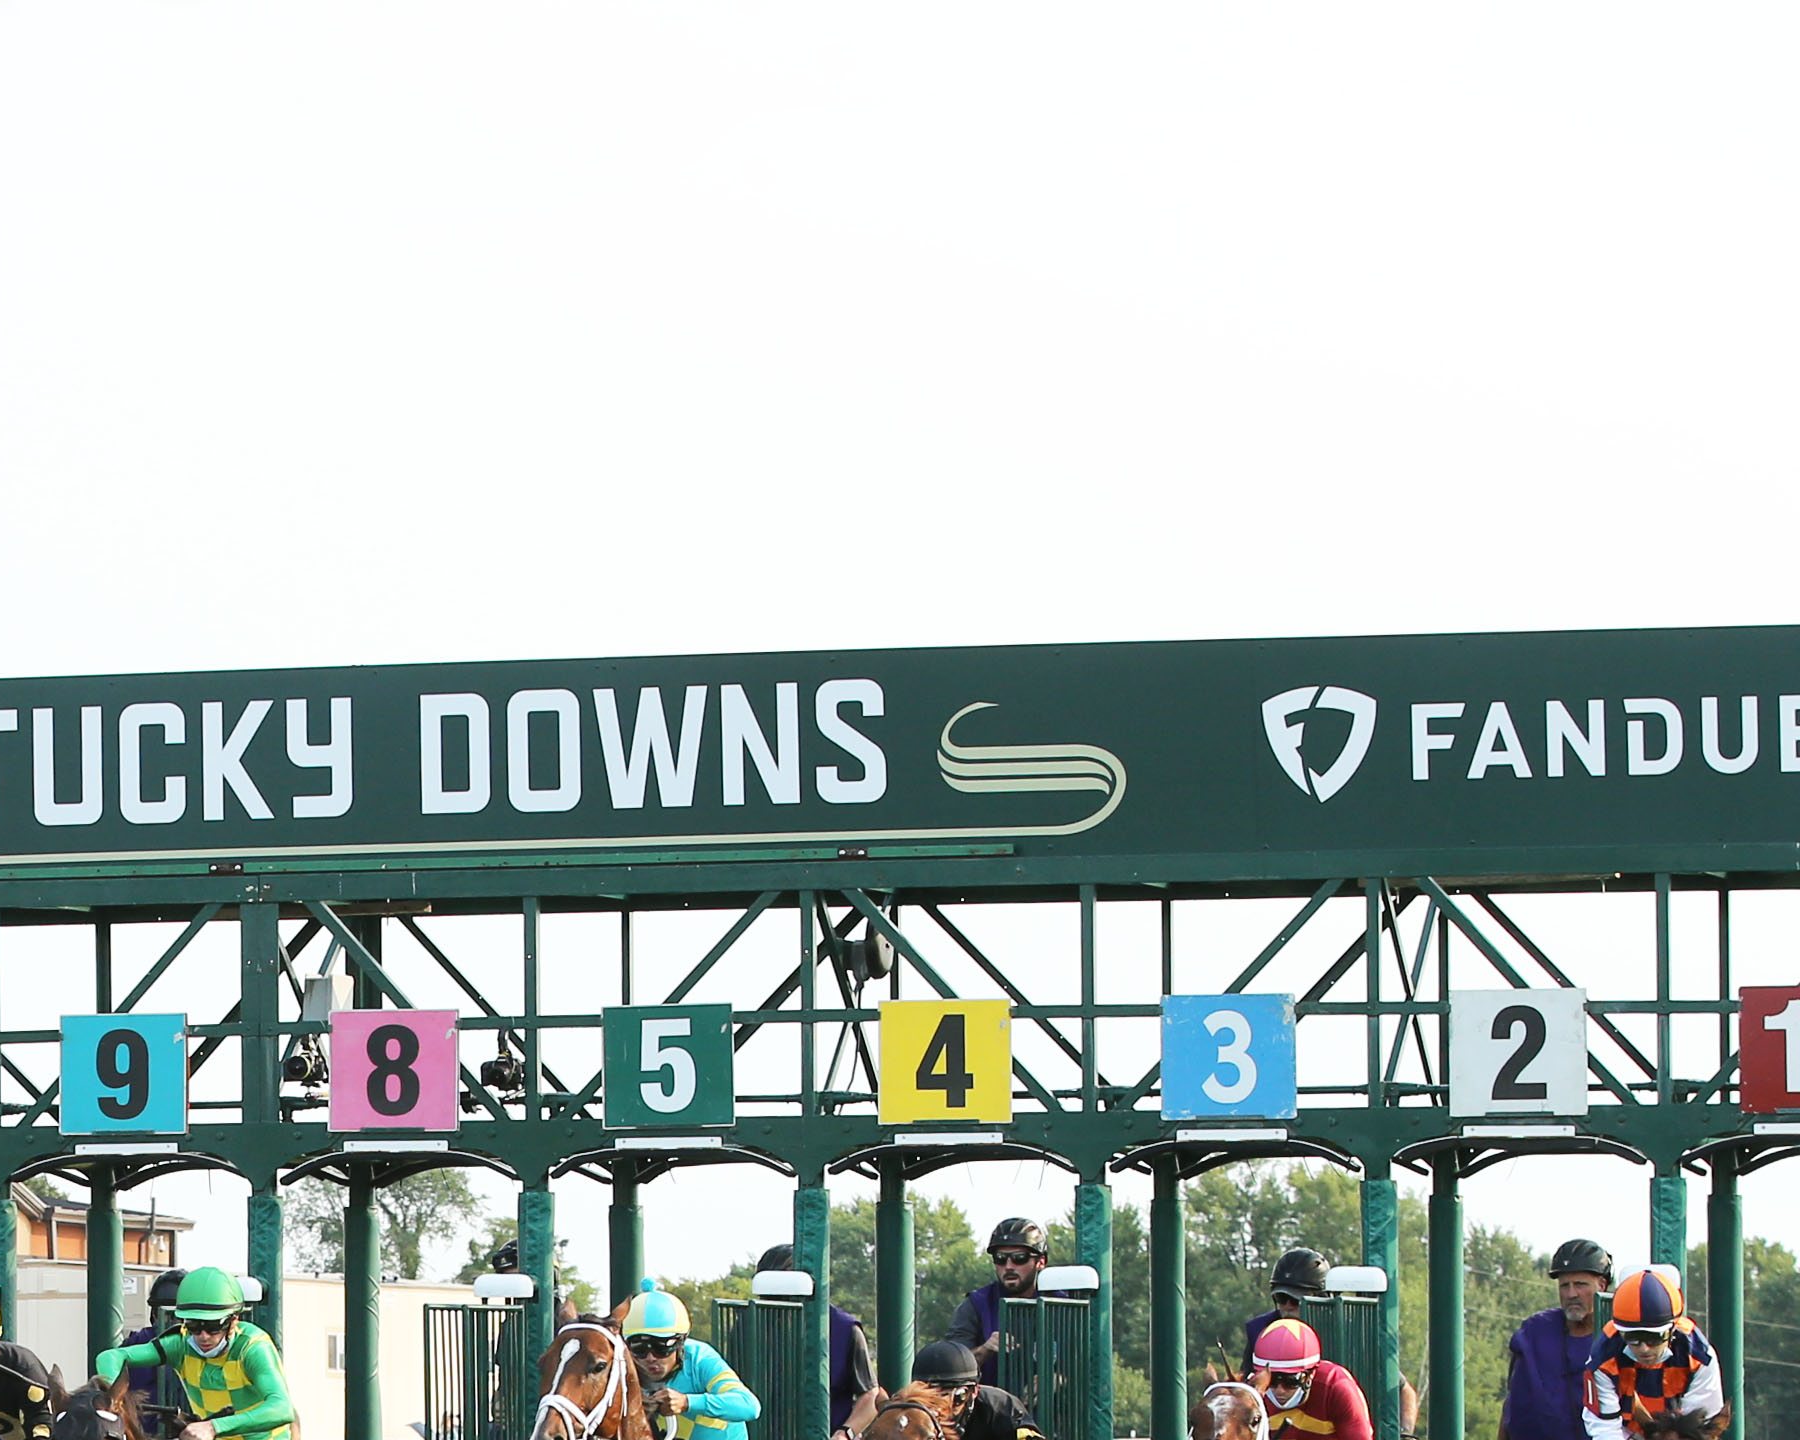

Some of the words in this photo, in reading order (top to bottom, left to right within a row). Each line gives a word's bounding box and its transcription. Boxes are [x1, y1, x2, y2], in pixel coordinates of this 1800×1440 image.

[419, 679, 887, 815] DOWNS
[95, 1028, 151, 1120] 9
[365, 1024, 420, 1117] 8
[639, 1018, 697, 1113] 5
[915, 1013, 974, 1108] 4
[1201, 1010, 1257, 1104] 3
[1490, 1005, 1547, 1100] 2
